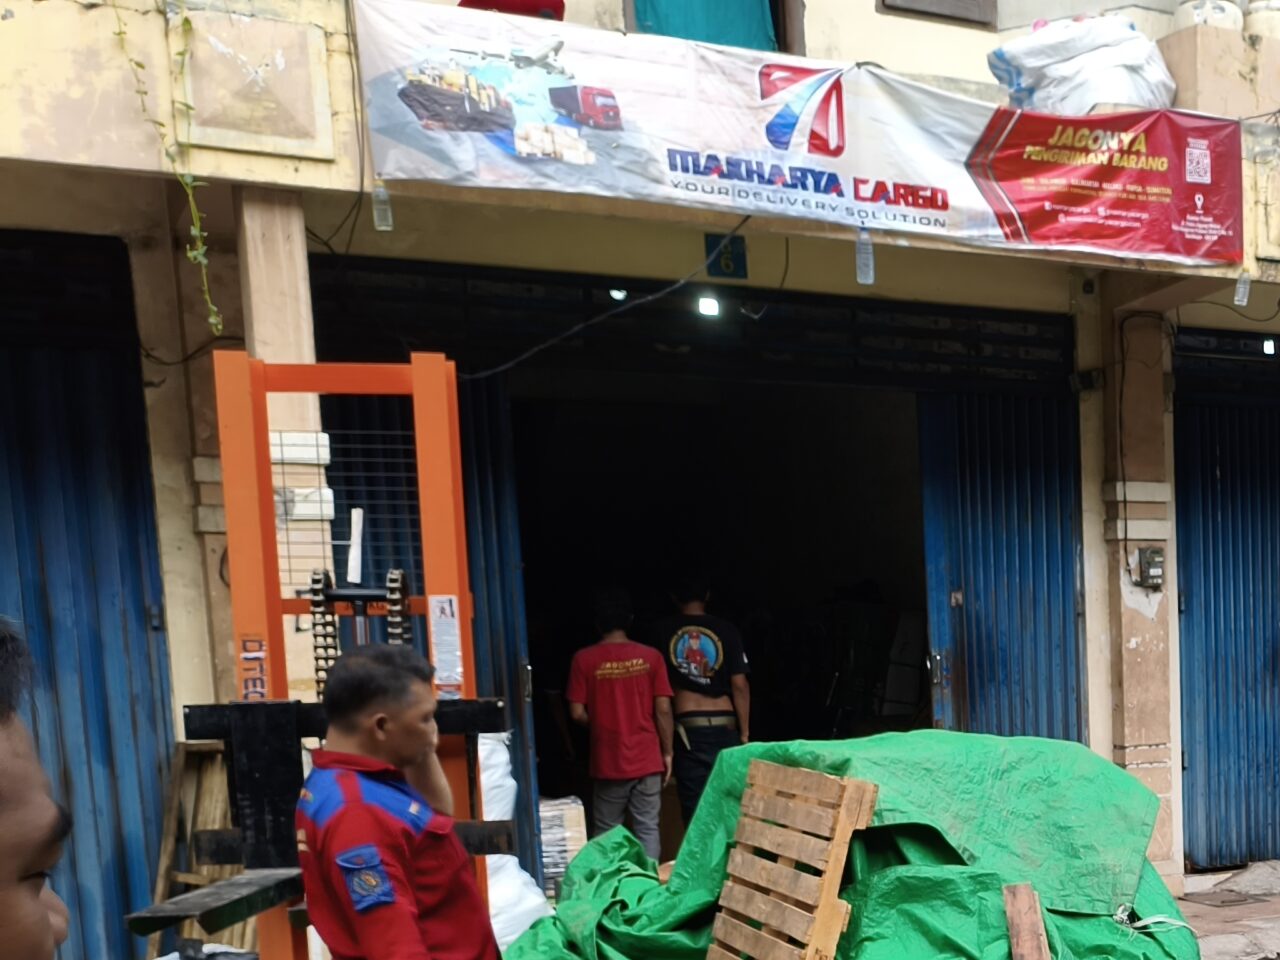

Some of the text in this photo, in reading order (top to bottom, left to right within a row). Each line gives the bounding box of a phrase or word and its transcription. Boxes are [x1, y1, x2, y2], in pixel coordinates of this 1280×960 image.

[1023, 145, 1169, 171] PENGIRIMAN BARANG
[1047, 125, 1147, 153] JAGONYA
[667, 148, 949, 211] MAKHARYA CARGO
[671, 180, 948, 228] YOUR DELIVERY SOLUTION
